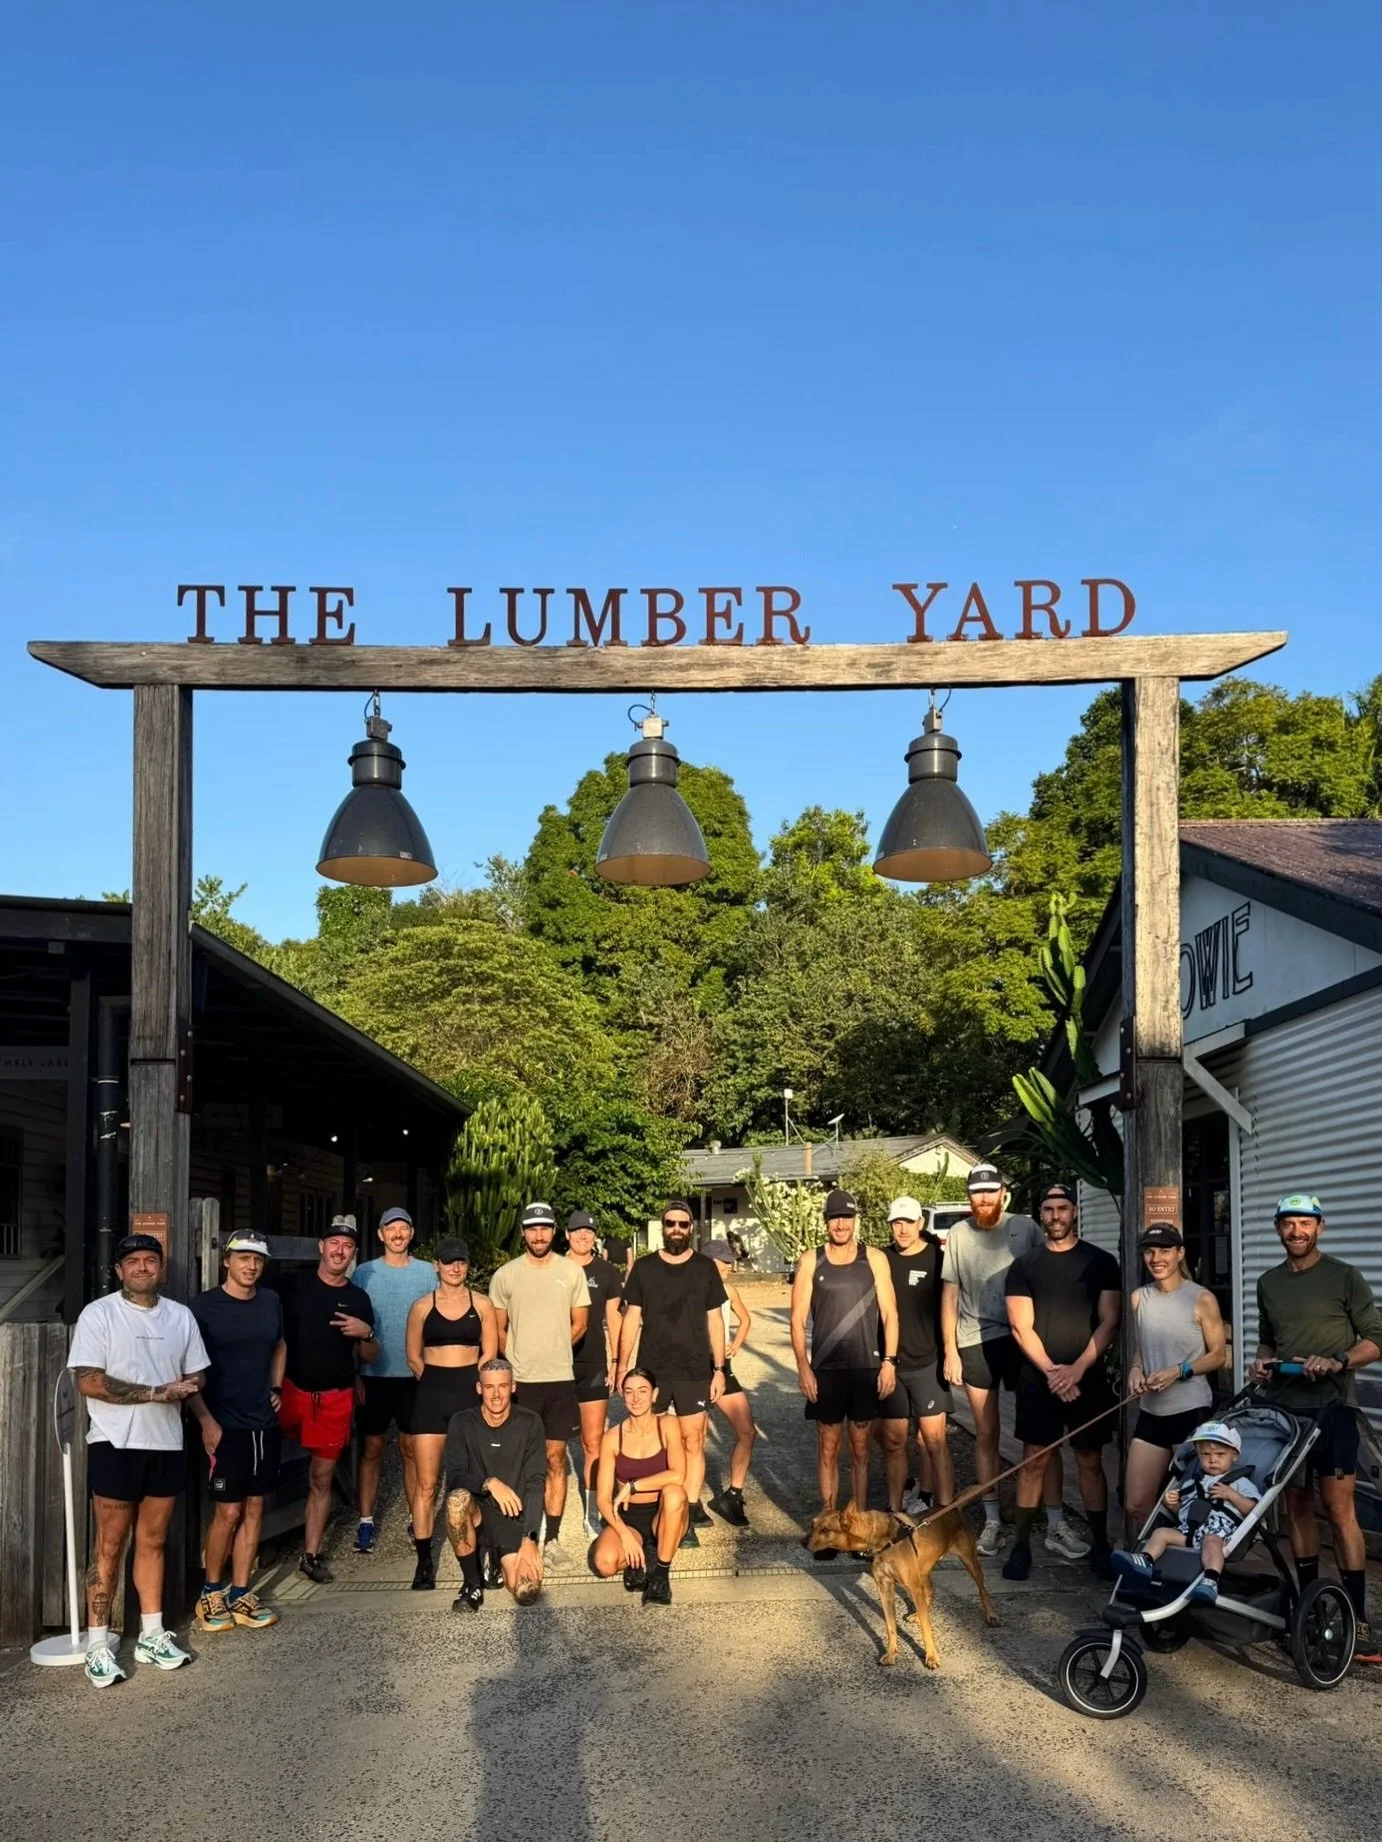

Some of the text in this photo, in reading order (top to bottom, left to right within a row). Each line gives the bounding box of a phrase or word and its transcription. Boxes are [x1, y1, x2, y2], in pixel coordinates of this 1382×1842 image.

[177, 578, 1136, 646] THE LUMBER YARD
